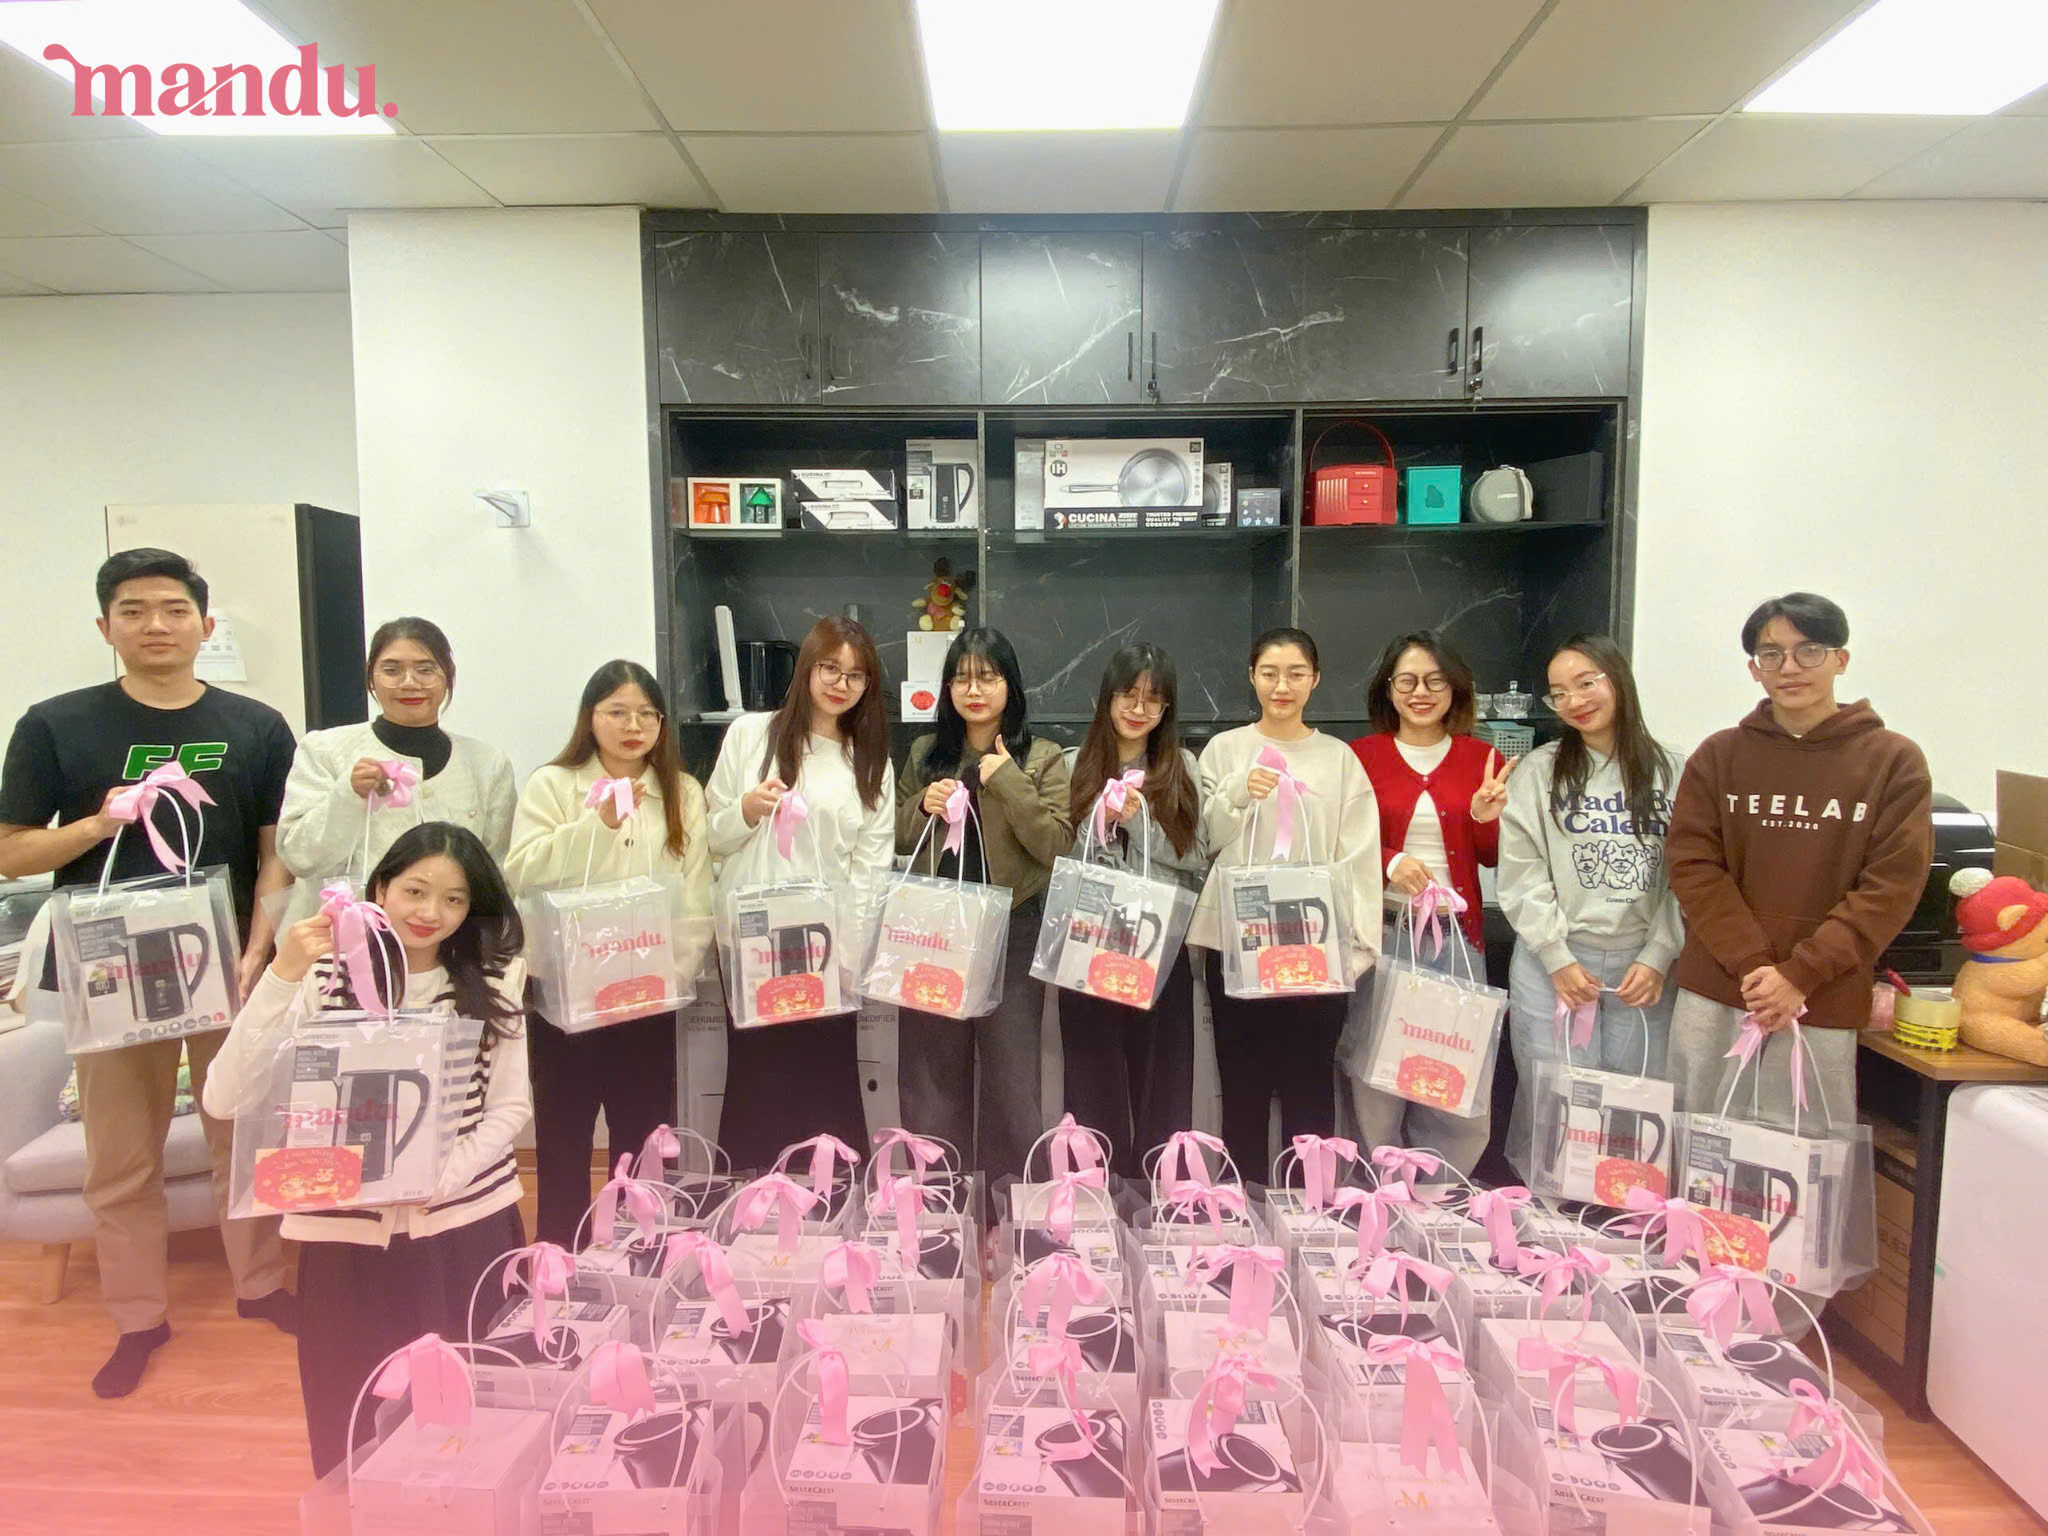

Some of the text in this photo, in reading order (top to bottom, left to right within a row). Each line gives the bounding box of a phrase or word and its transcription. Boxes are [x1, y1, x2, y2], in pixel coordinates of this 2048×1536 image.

[1068, 513, 1117, 523] CUCINA
[1726, 794, 1868, 822] TEELAB
[1761, 819, 1819, 830] EST.2020
[1397, 1016, 1475, 1055] mandu.
